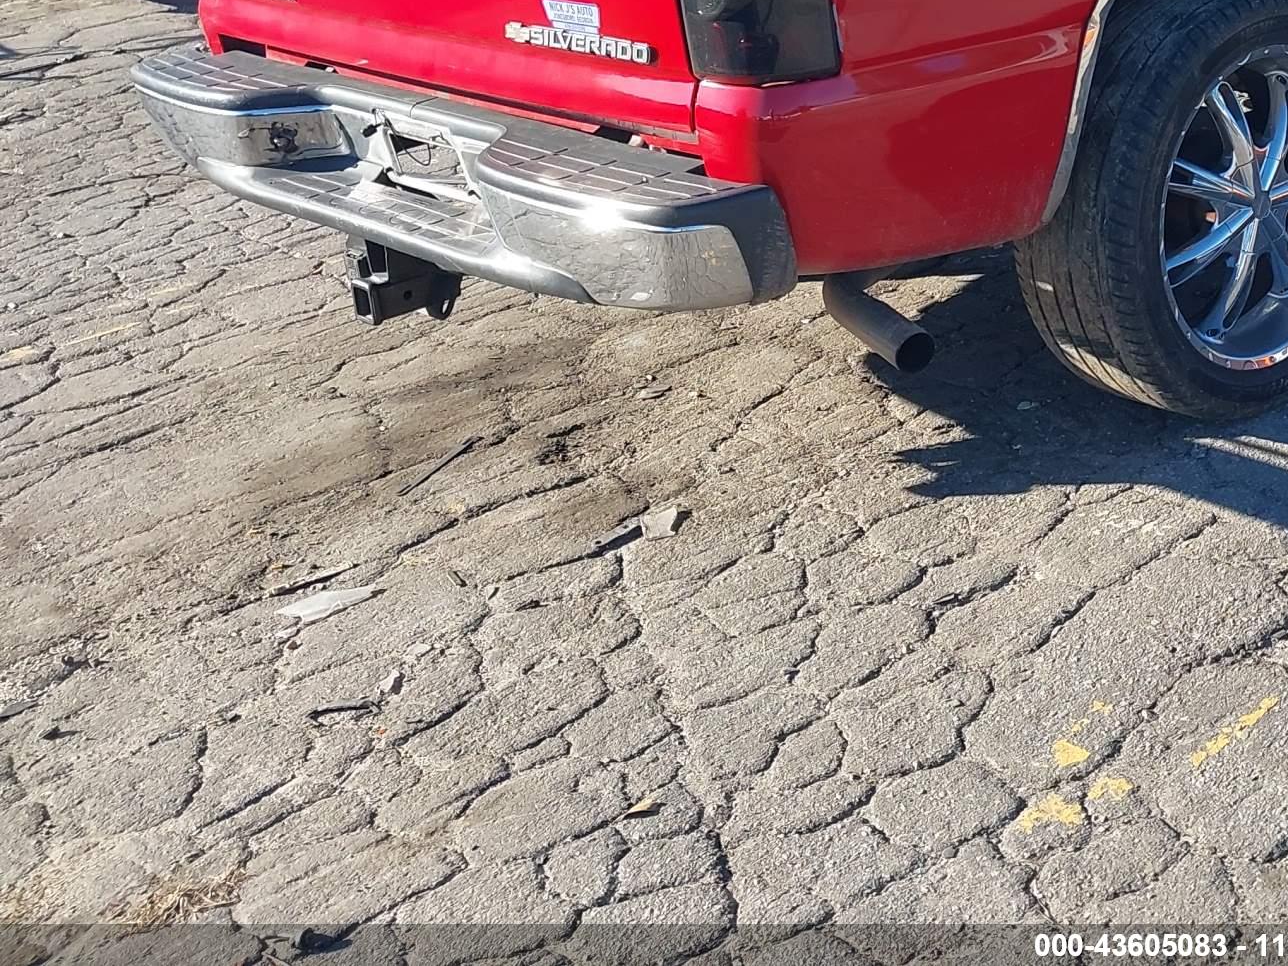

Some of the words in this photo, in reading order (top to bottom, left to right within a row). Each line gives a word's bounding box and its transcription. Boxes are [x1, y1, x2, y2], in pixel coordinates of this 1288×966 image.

[548, 1, 564, 13] NICK
[577, 6, 594, 18] AUTO
[530, 26, 650, 64] SILVERADO
